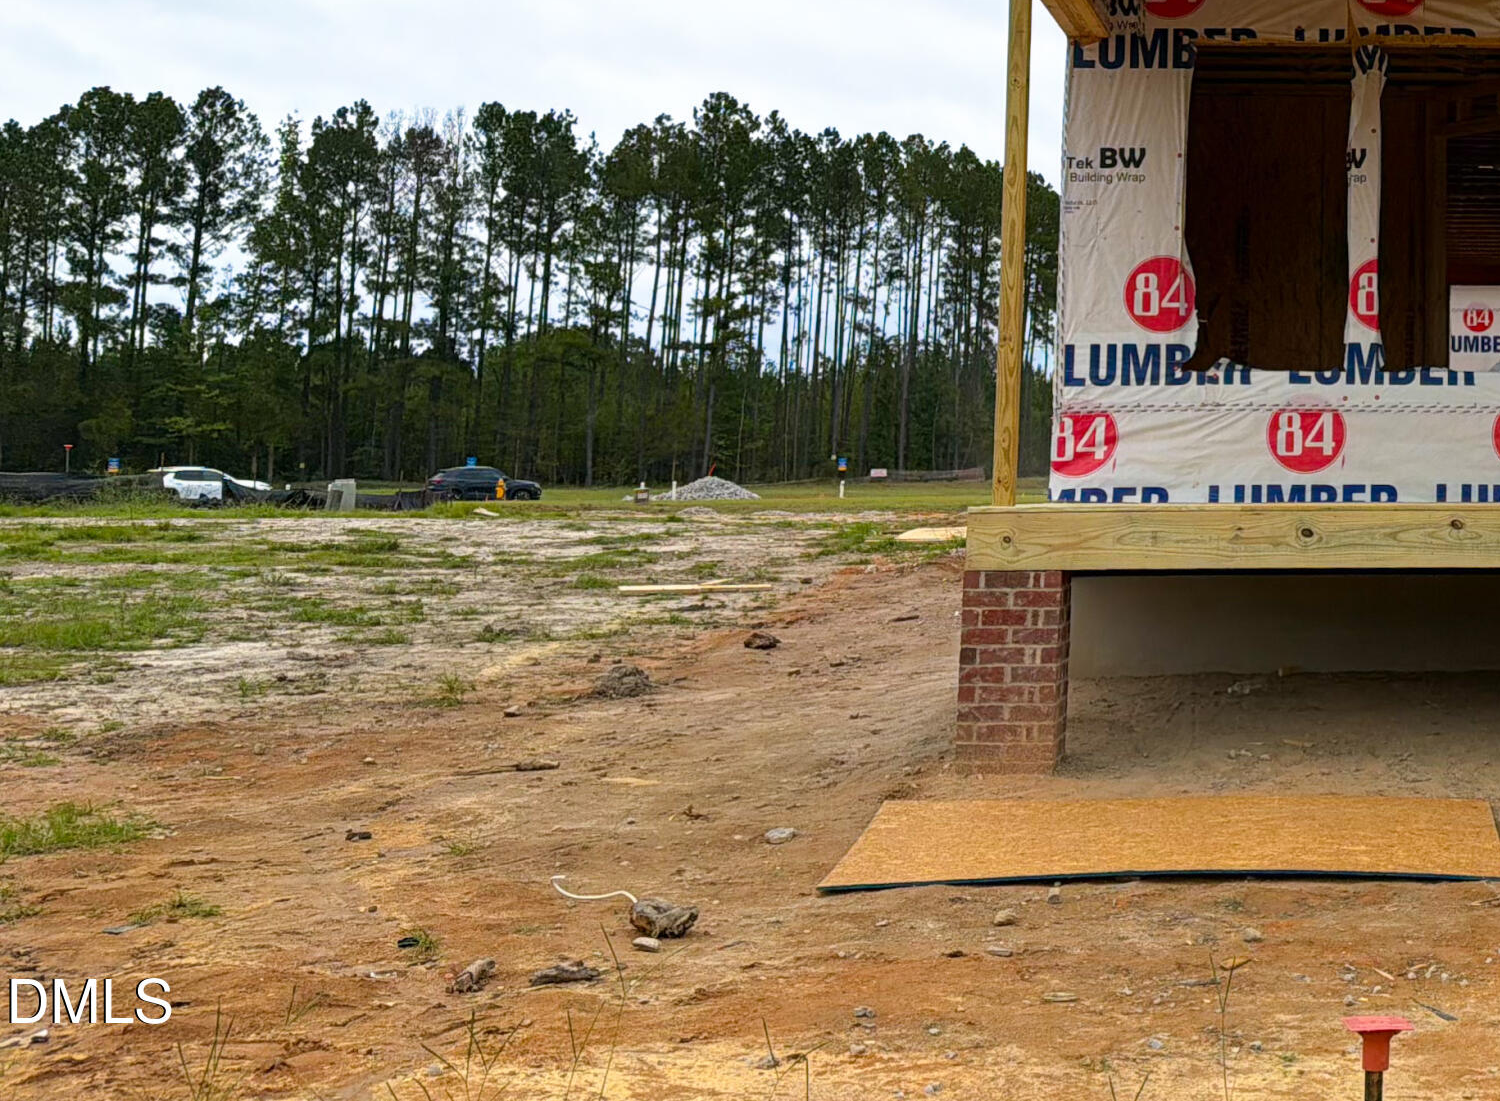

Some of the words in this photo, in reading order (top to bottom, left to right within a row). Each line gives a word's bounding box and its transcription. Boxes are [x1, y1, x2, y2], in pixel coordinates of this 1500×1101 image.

[1099, 147, 1146, 169] BW
[1070, 172, 1113, 184] Building
[1116, 173, 1146, 184] Wrap
[1134, 272, 1188, 316] 84
[1467, 310, 1491, 327] 84
[1052, 416, 1107, 461] 84
[1277, 412, 1335, 456] 84
